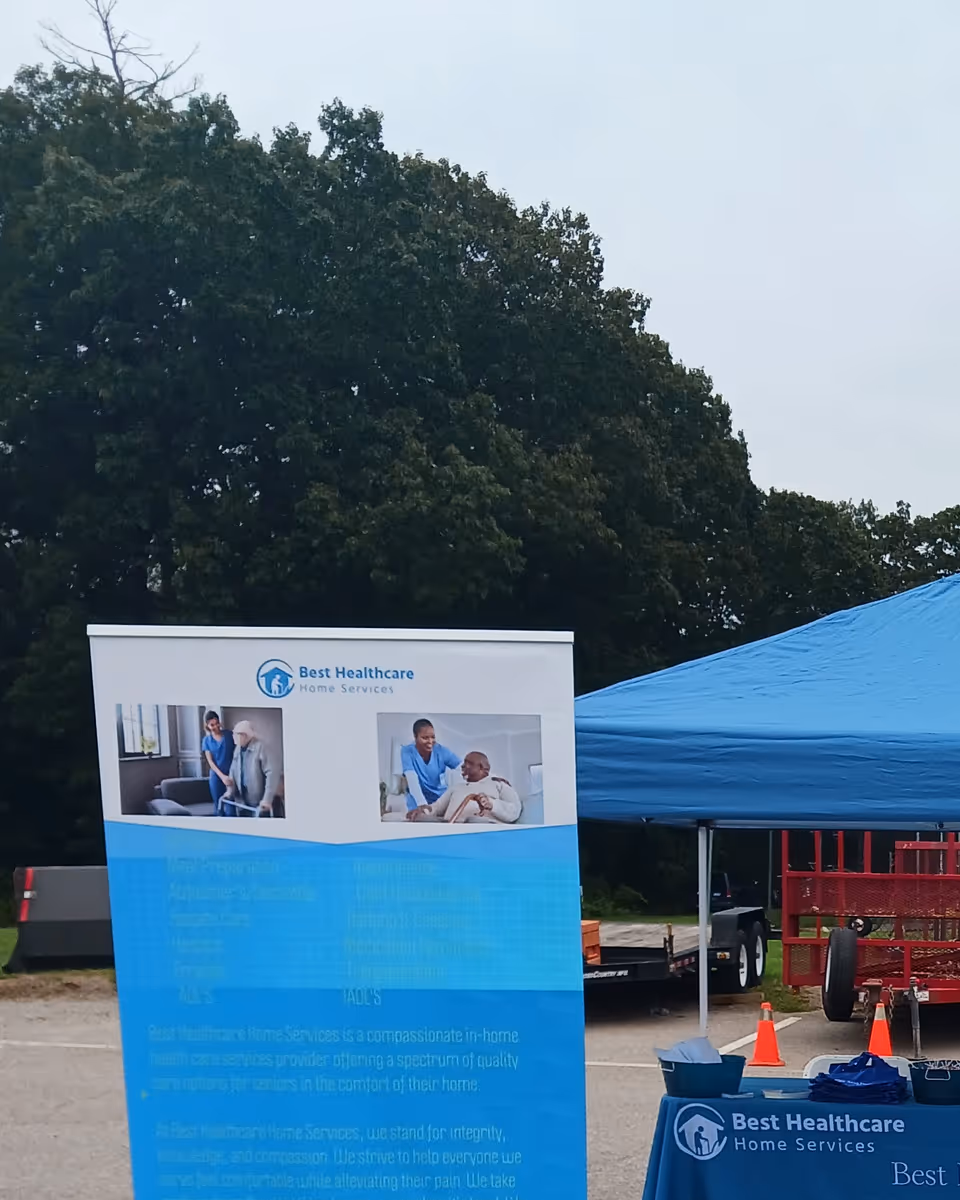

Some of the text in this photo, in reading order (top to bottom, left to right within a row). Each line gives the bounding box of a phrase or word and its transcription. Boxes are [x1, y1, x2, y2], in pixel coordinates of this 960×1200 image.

[299, 666, 415, 681] Best Healthcare
[299, 683, 395, 695] Home Services
[287, 1026, 340, 1043] Services
[342, 1027, 354, 1042] is
[356, 1030, 364, 1042] a
[367, 1027, 463, 1045] compassionate
[465, 1027, 519, 1044] in-home
[275, 1052, 328, 1069] provider
[387, 1056, 394, 1067] a
[397, 1053, 460, 1071] spectrum
[462, 1052, 474, 1070] of
[477, 1051, 519, 1071] quality
[337, 1075, 390, 1095] comfort
[392, 1075, 405, 1095] of
[408, 1075, 439, 1093] their
[732, 1113, 904, 1132] Best Healthcare
[368, 1127, 387, 1141] we
[390, 1125, 425, 1141] stand
[426, 1124, 447, 1143] for
[735, 1138, 874, 1152] Home Services
[358, 1149, 395, 1165] strive
[397, 1149, 410, 1164] to
[412, 1149, 440, 1166] help
[442, 1151, 499, 1167] everyone
[501, 1150, 522, 1164] we
[334, 1173, 398, 1192] alleviating
[401, 1174, 432, 1189] their
[466, 1172, 487, 1189] We
[489, 1173, 516, 1189] take
[892, 1162, 947, 1185] Best
